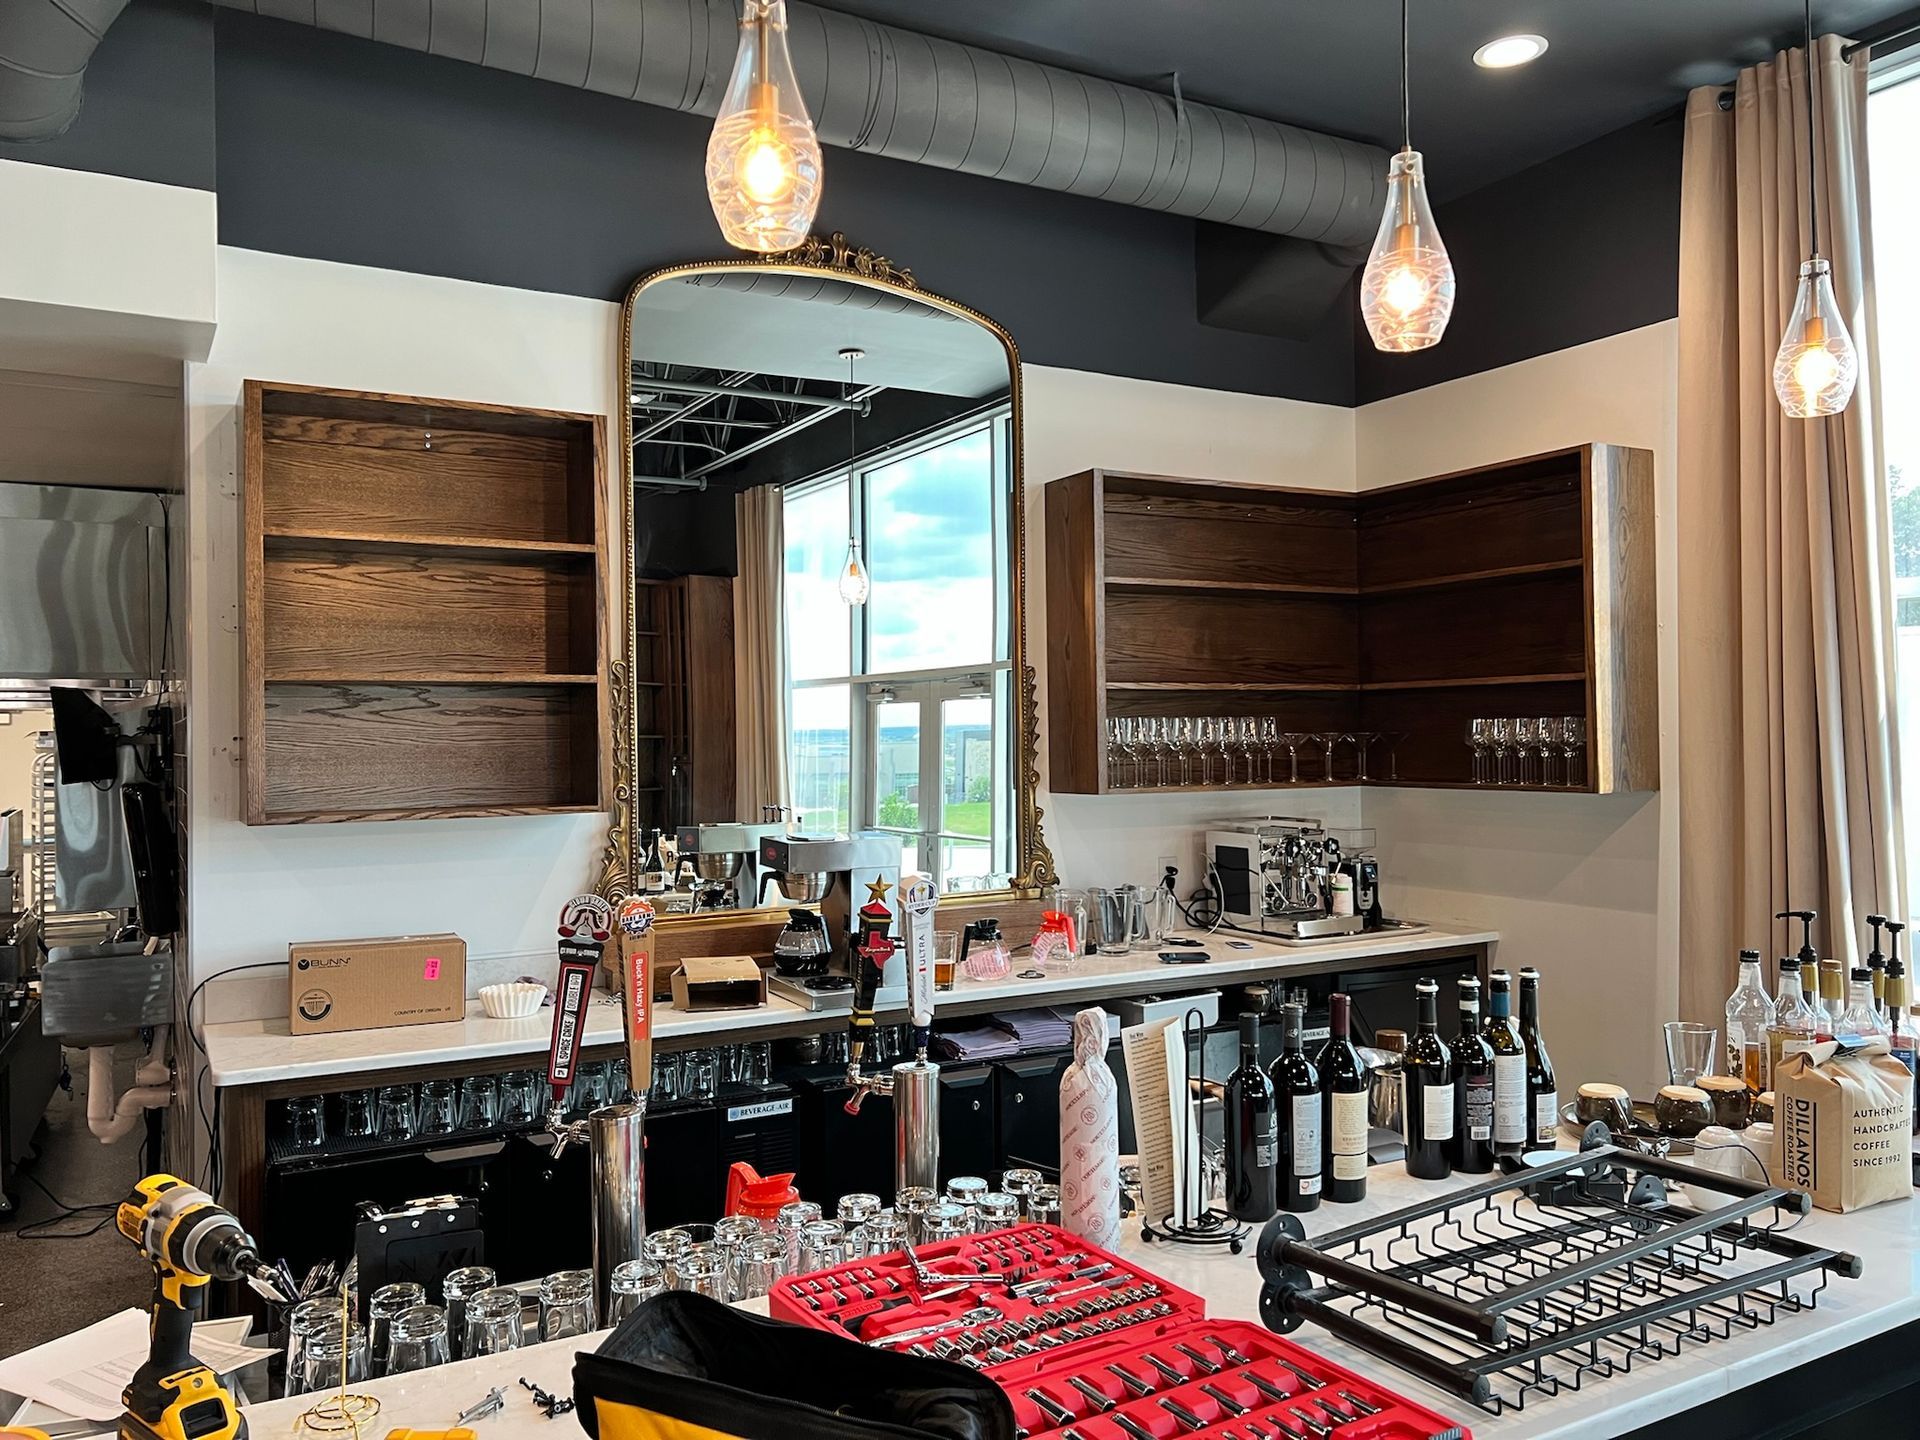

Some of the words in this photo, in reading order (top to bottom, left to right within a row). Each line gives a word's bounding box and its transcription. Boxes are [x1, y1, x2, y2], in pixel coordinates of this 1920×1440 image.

[918, 934, 926, 966] ULTRA
[311, 958, 350, 966] BUNN
[635, 958, 644, 986] Buck'n
[566, 987, 579, 1010] DOUBLE
[635, 987, 645, 1008] Hazy
[637, 1009, 645, 1023] IPA
[562, 1020, 574, 1037] CAKE
[560, 1038, 571, 1059] SPACE
[1786, 1096, 1794, 1133] COFFEE
[1853, 1105, 1904, 1118] AUTHENTIC
[1795, 1099, 1811, 1189] DILLANOS
[1853, 1140, 1890, 1151] COFFEE
[1787, 1134, 1795, 1183] ROASTERS
[1853, 1157, 1883, 1167] SINCE
[1885, 1154, 1901, 1164] 1992
